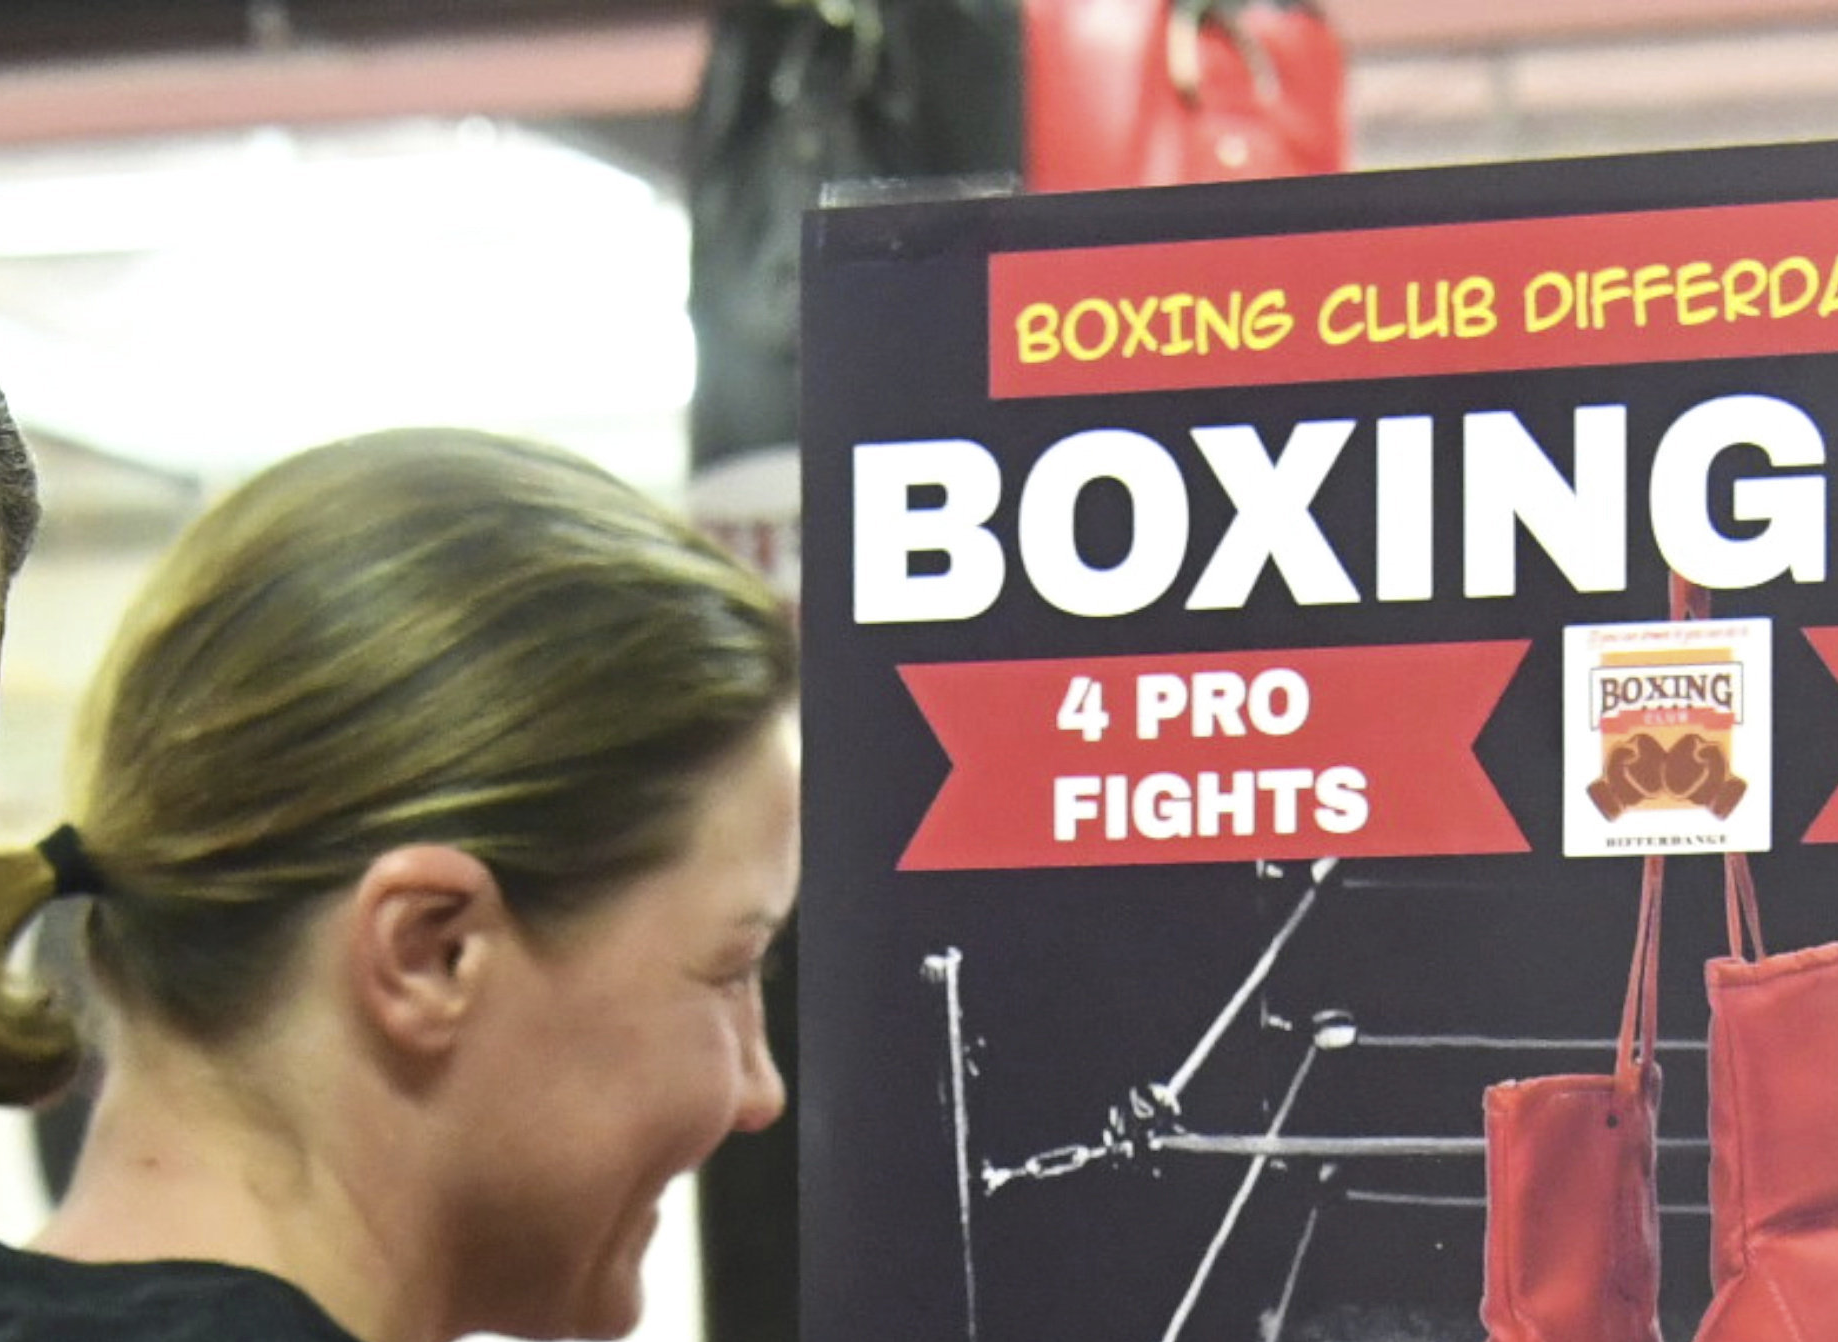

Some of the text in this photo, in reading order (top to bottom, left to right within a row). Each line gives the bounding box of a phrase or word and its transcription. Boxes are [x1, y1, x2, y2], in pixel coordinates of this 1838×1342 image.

[1014, 290, 1294, 365] BOXING
[1316, 275, 1499, 346] CLUB
[852, 393, 1827, 625] BOXING
[1056, 667, 1310, 742] 4 PRO
[1599, 674, 1733, 714] BOXING
[1053, 766, 1369, 842] FIGHTS
